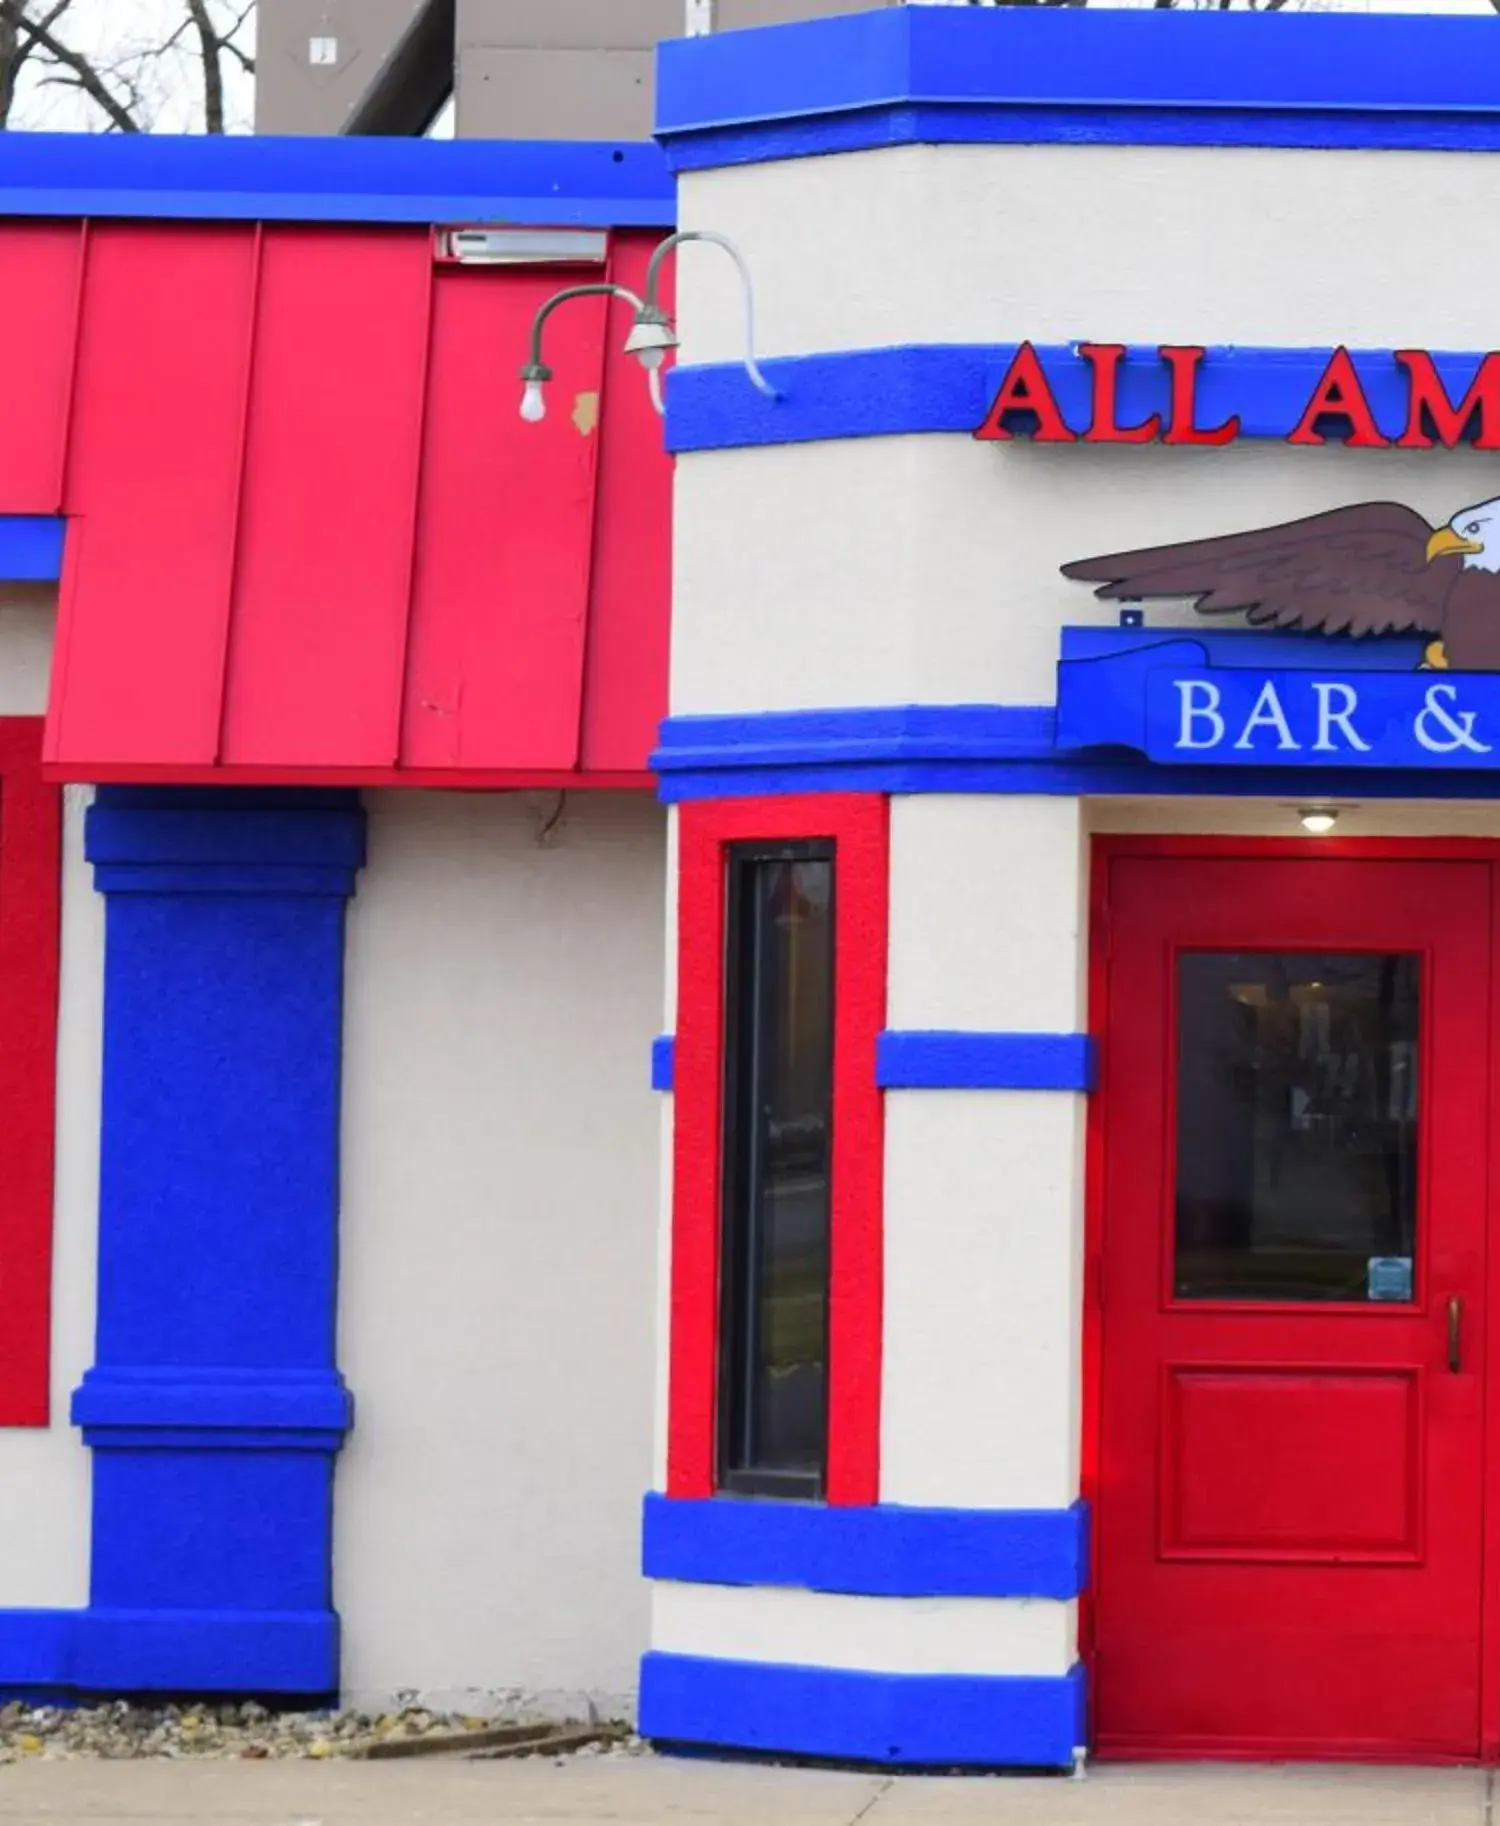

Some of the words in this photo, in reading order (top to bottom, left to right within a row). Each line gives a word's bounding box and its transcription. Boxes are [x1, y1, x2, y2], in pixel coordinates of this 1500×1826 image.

[973, 340, 1240, 445] ALL
[1173, 679, 1373, 753] BAR
[1412, 682, 1492, 754] &
